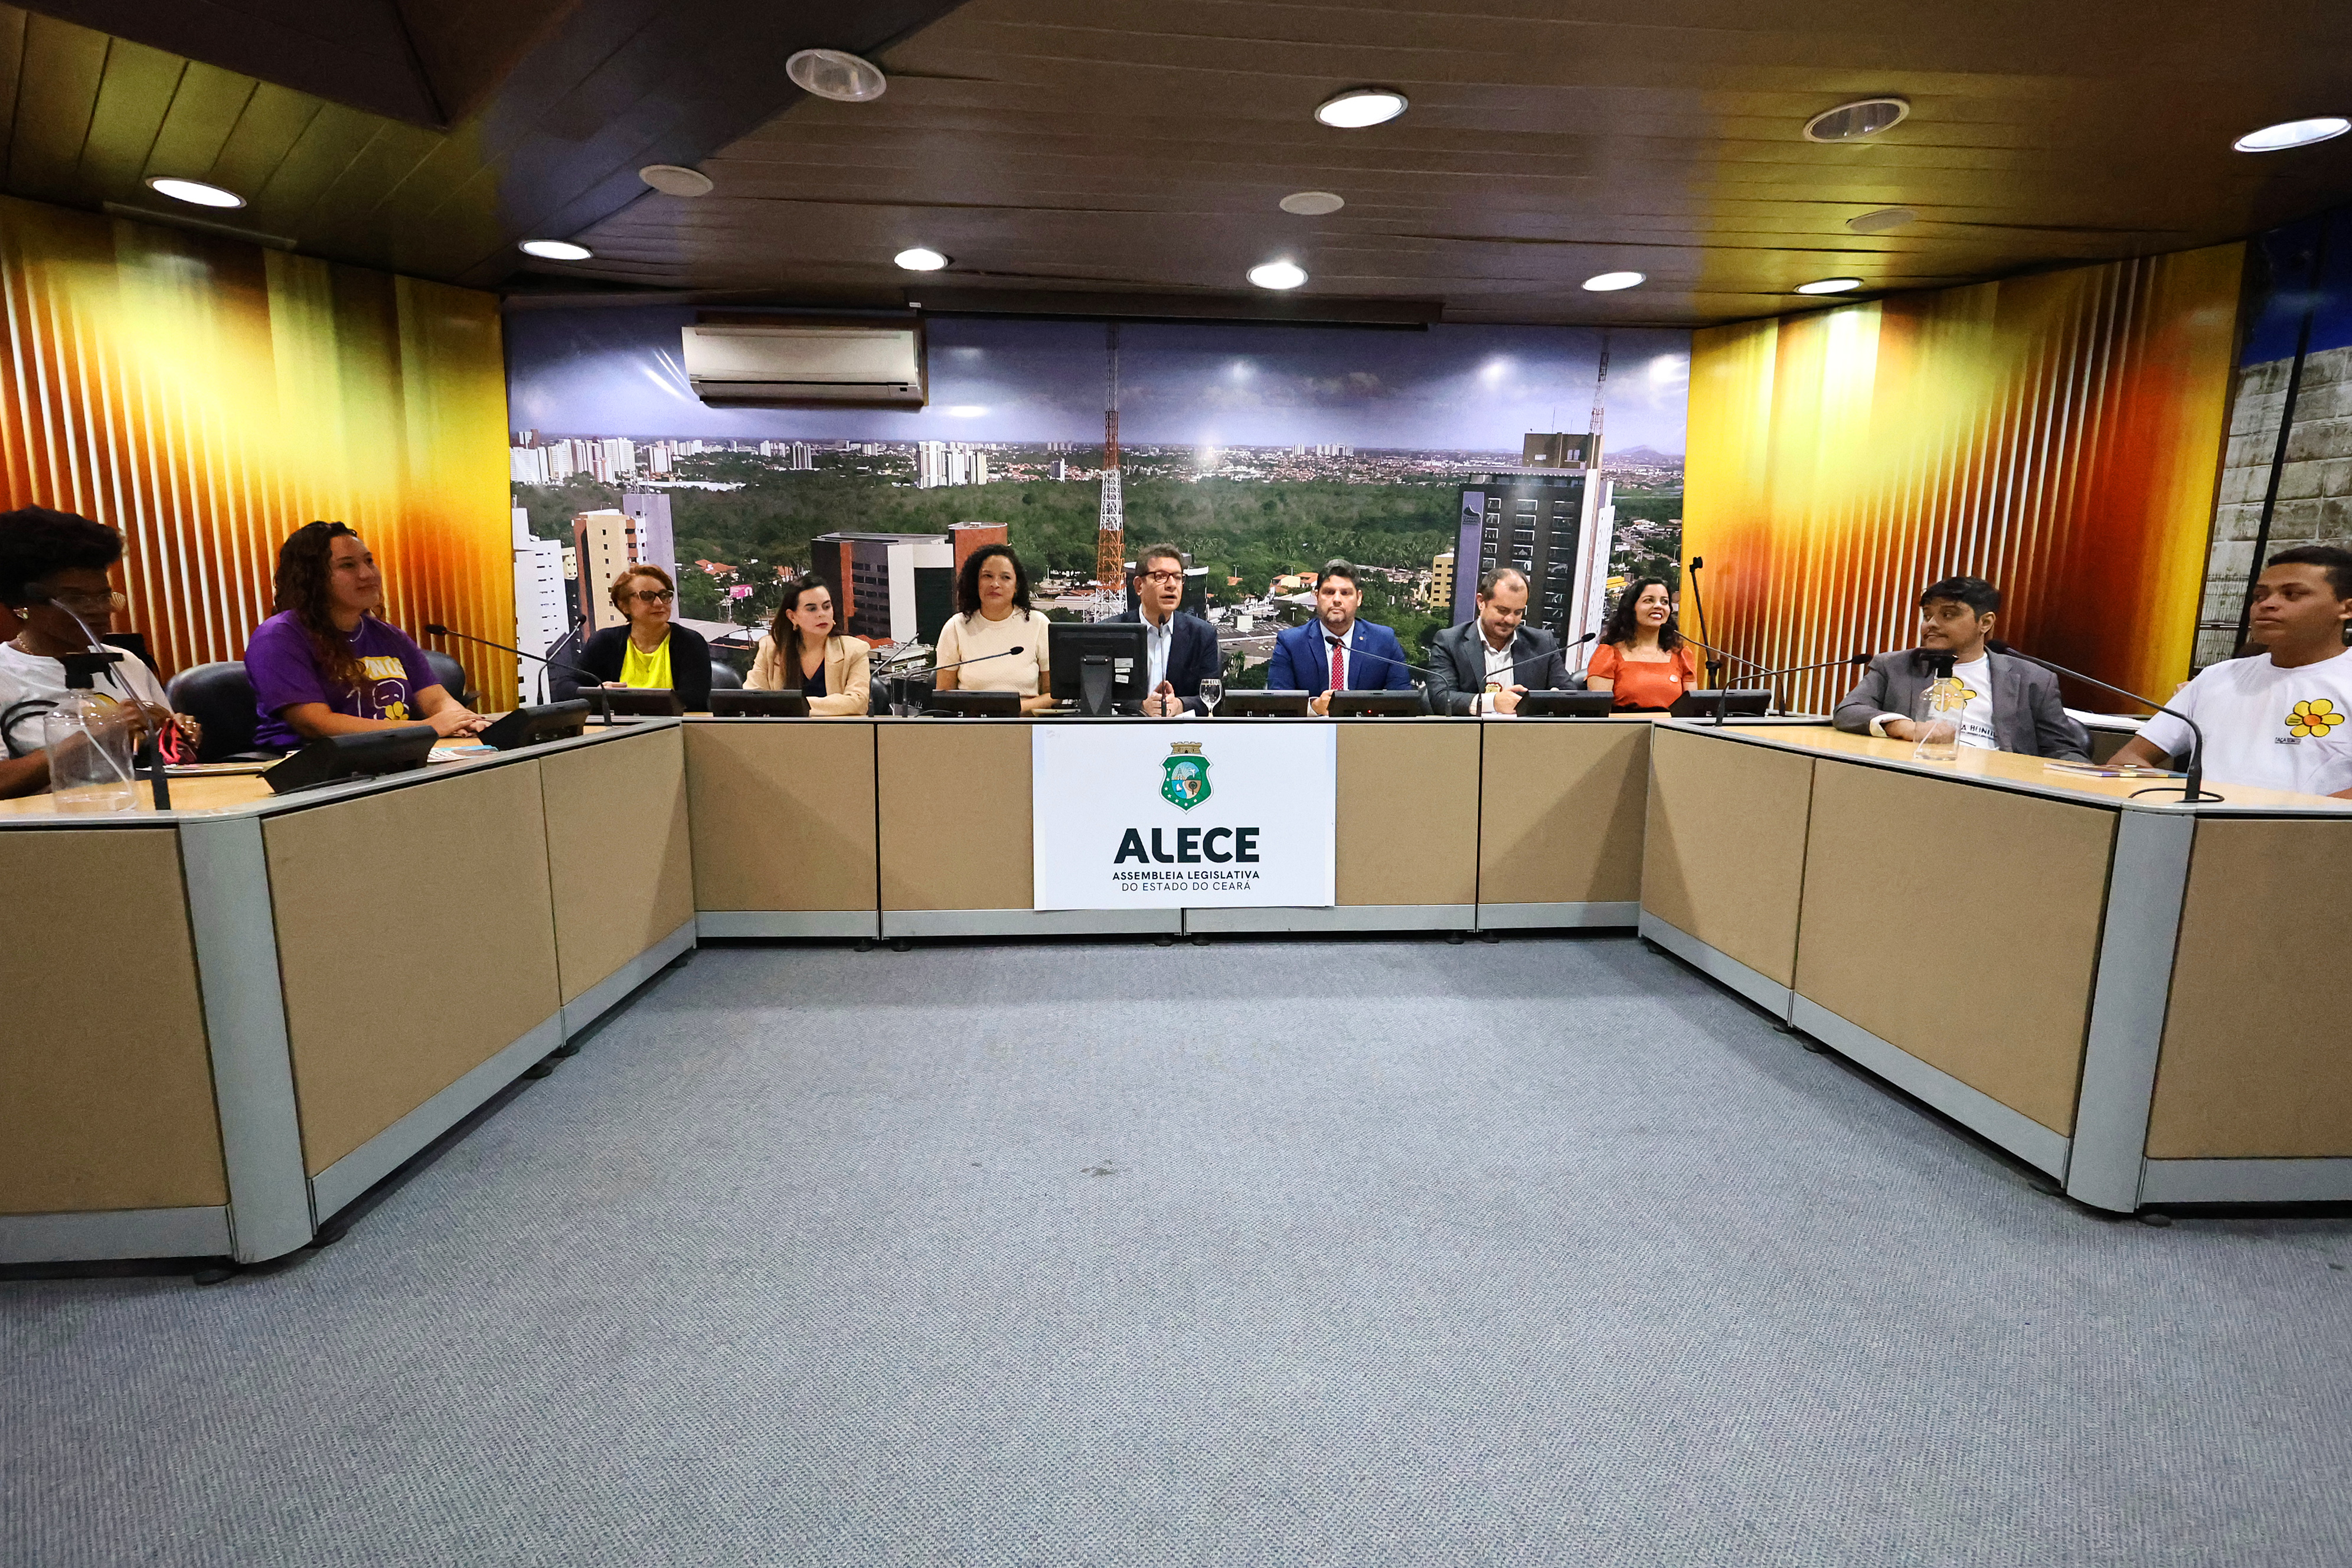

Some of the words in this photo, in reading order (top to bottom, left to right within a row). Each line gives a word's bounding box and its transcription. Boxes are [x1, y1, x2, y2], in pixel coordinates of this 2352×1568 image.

[1113, 827, 1260, 864] ALECE
[1112, 871, 1184, 880] ASSEMBLEIA
[1188, 871, 1260, 880] LEGISLATIVA
[1122, 883, 1138, 891] DO
[1142, 882, 1188, 891] ESTADO
[1193, 881, 1208, 891] DO
[1213, 879, 1251, 890] CEARÁ
